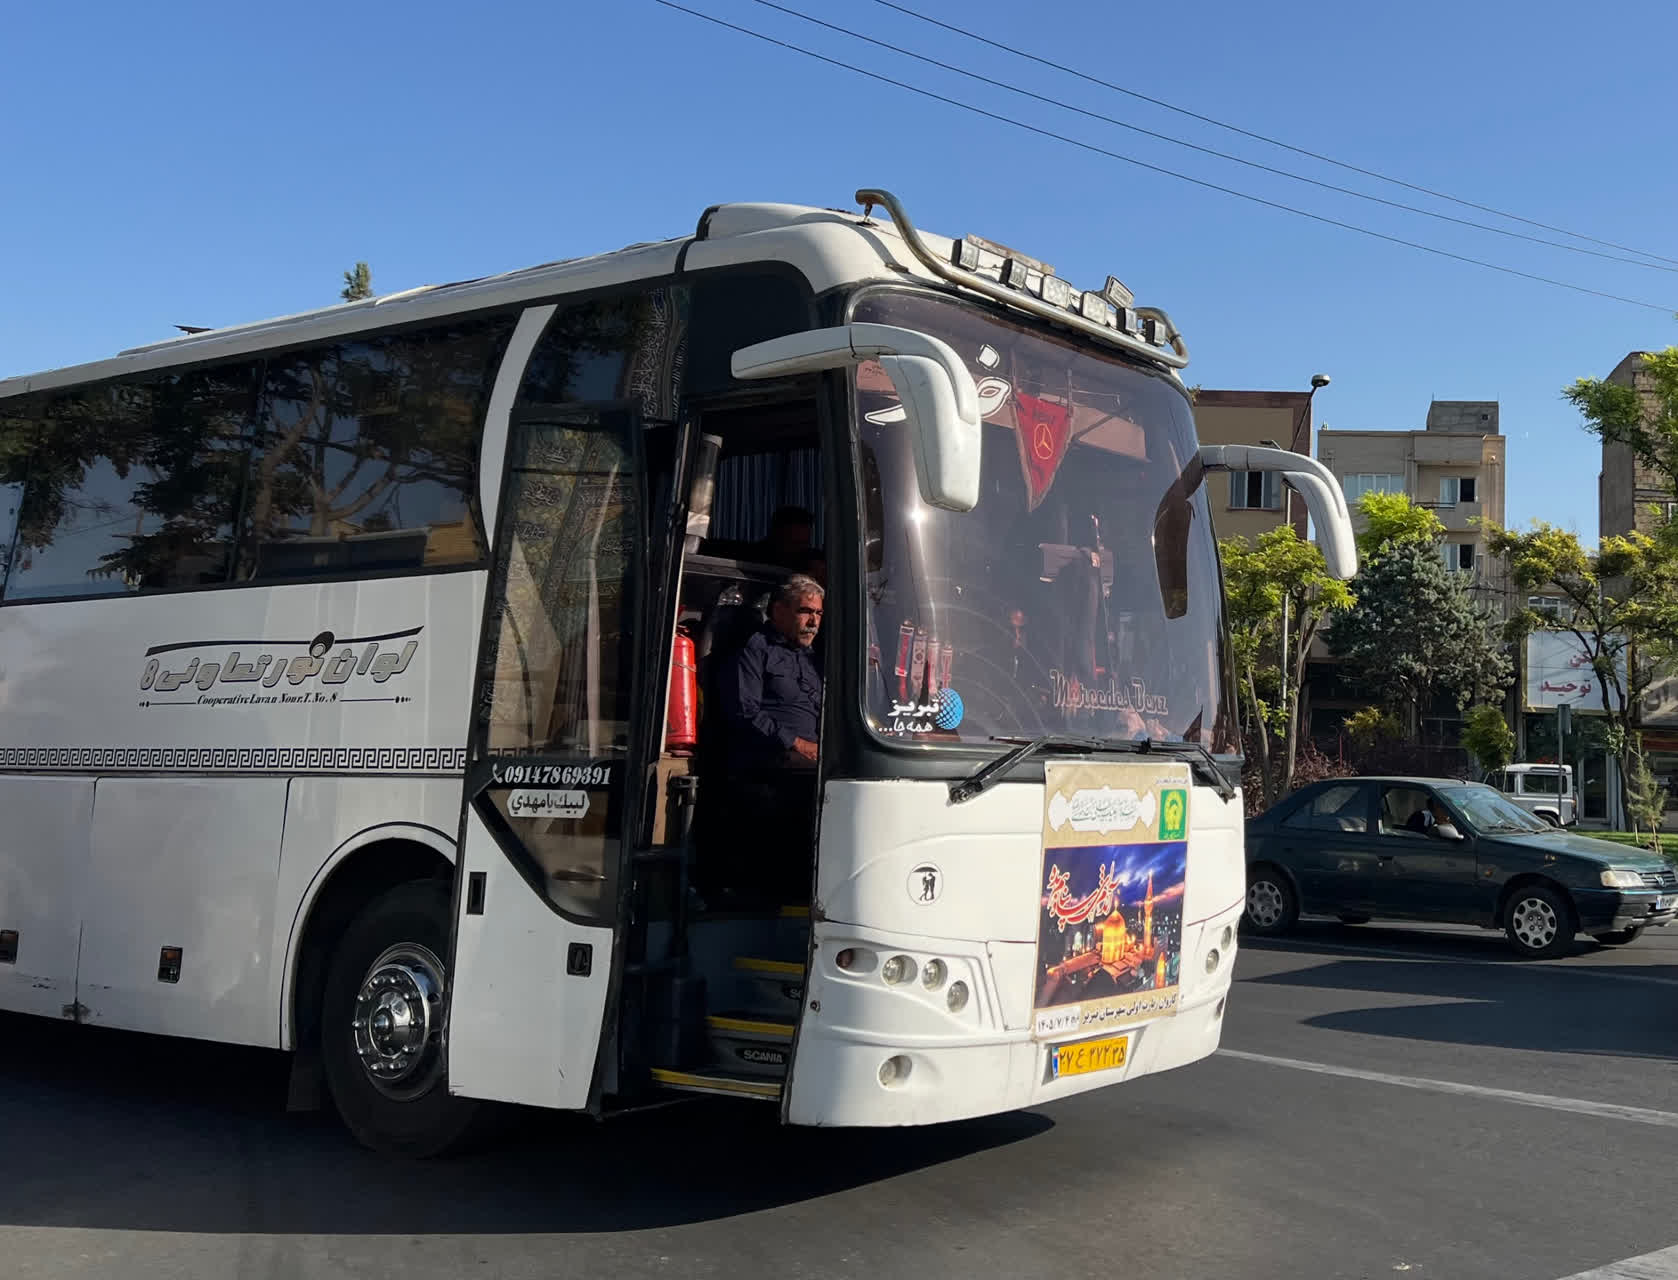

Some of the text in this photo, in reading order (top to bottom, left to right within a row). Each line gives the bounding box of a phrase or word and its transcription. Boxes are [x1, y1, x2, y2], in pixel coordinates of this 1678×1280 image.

[154, 651, 274, 692] تعاونی
[262, 643, 326, 689] نور
[321, 640, 419, 684] لوان
[1539, 679, 1592, 698] توحید
[196, 694, 249, 708] Cooperative
[249, 693, 278, 705] Lavan
[887, 699, 940, 717] تبریز
[504, 765, 612, 785] 09147869391
[743, 1049, 783, 1064] SCANIA
